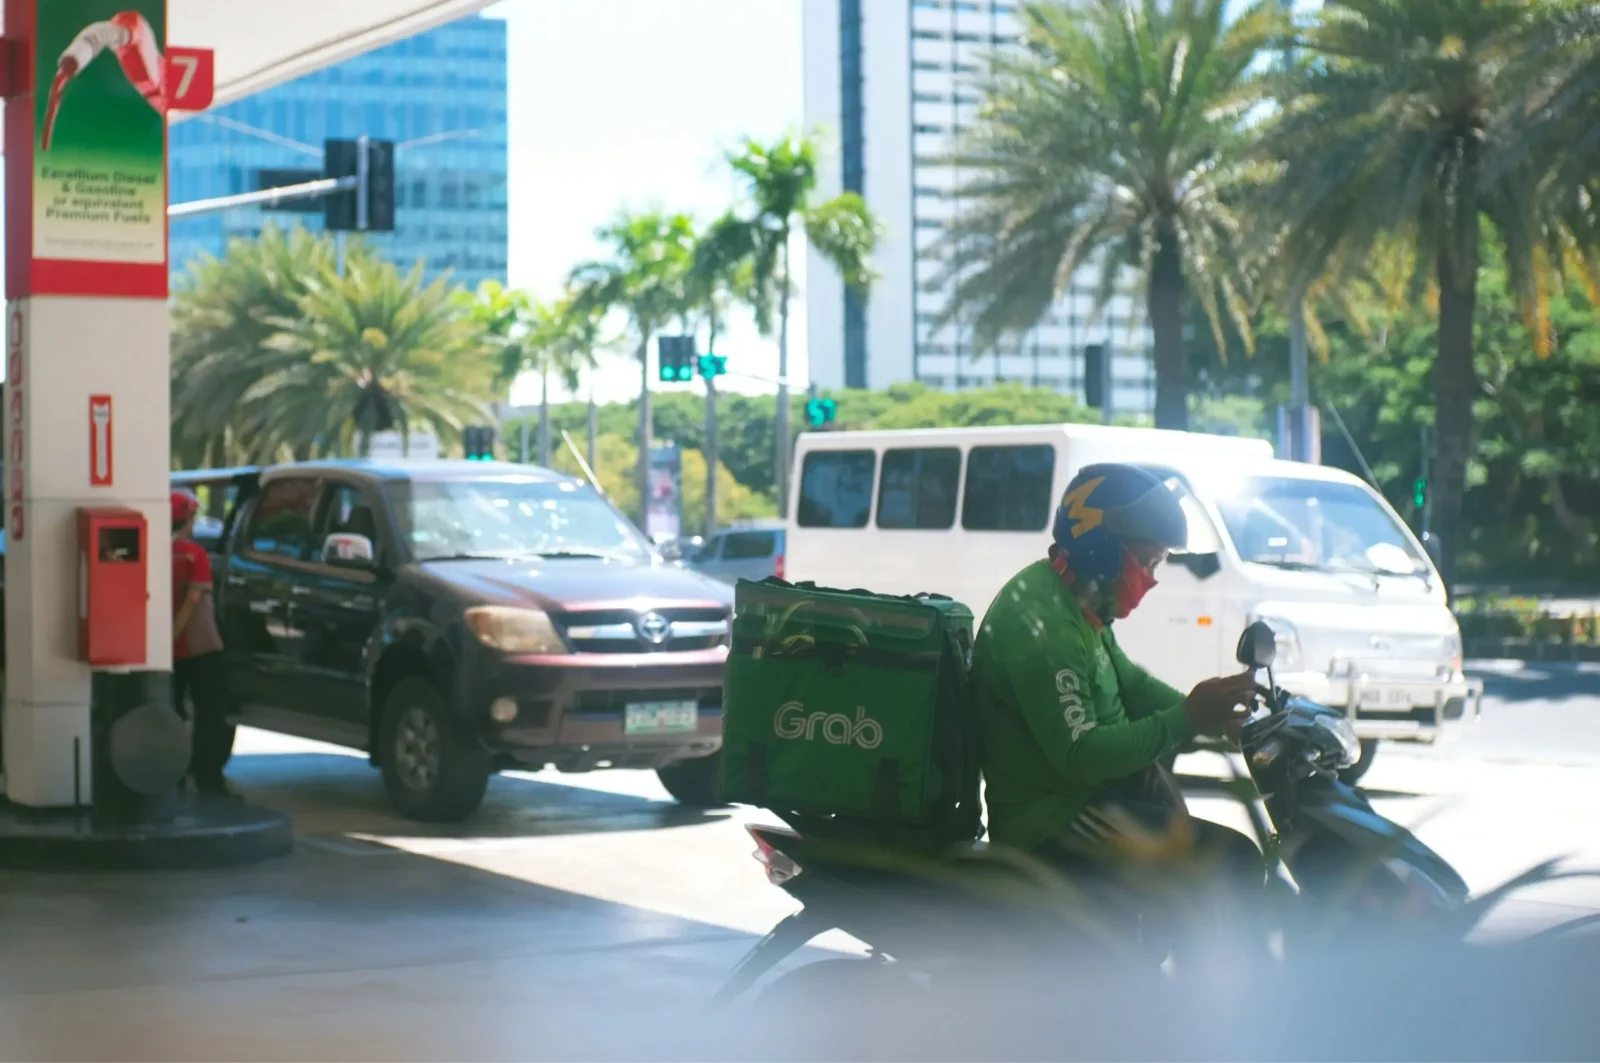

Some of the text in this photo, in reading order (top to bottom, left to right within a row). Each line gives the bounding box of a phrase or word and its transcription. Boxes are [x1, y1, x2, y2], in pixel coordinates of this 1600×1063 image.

[171, 55, 199, 100] 7
[113, 171, 157, 185] Diesel
[75, 182, 137, 197] Gasoline
[53, 196, 144, 211] or equivalent
[45, 207, 150, 225] Premium Fuels
[773, 700, 883, 750] Grab
